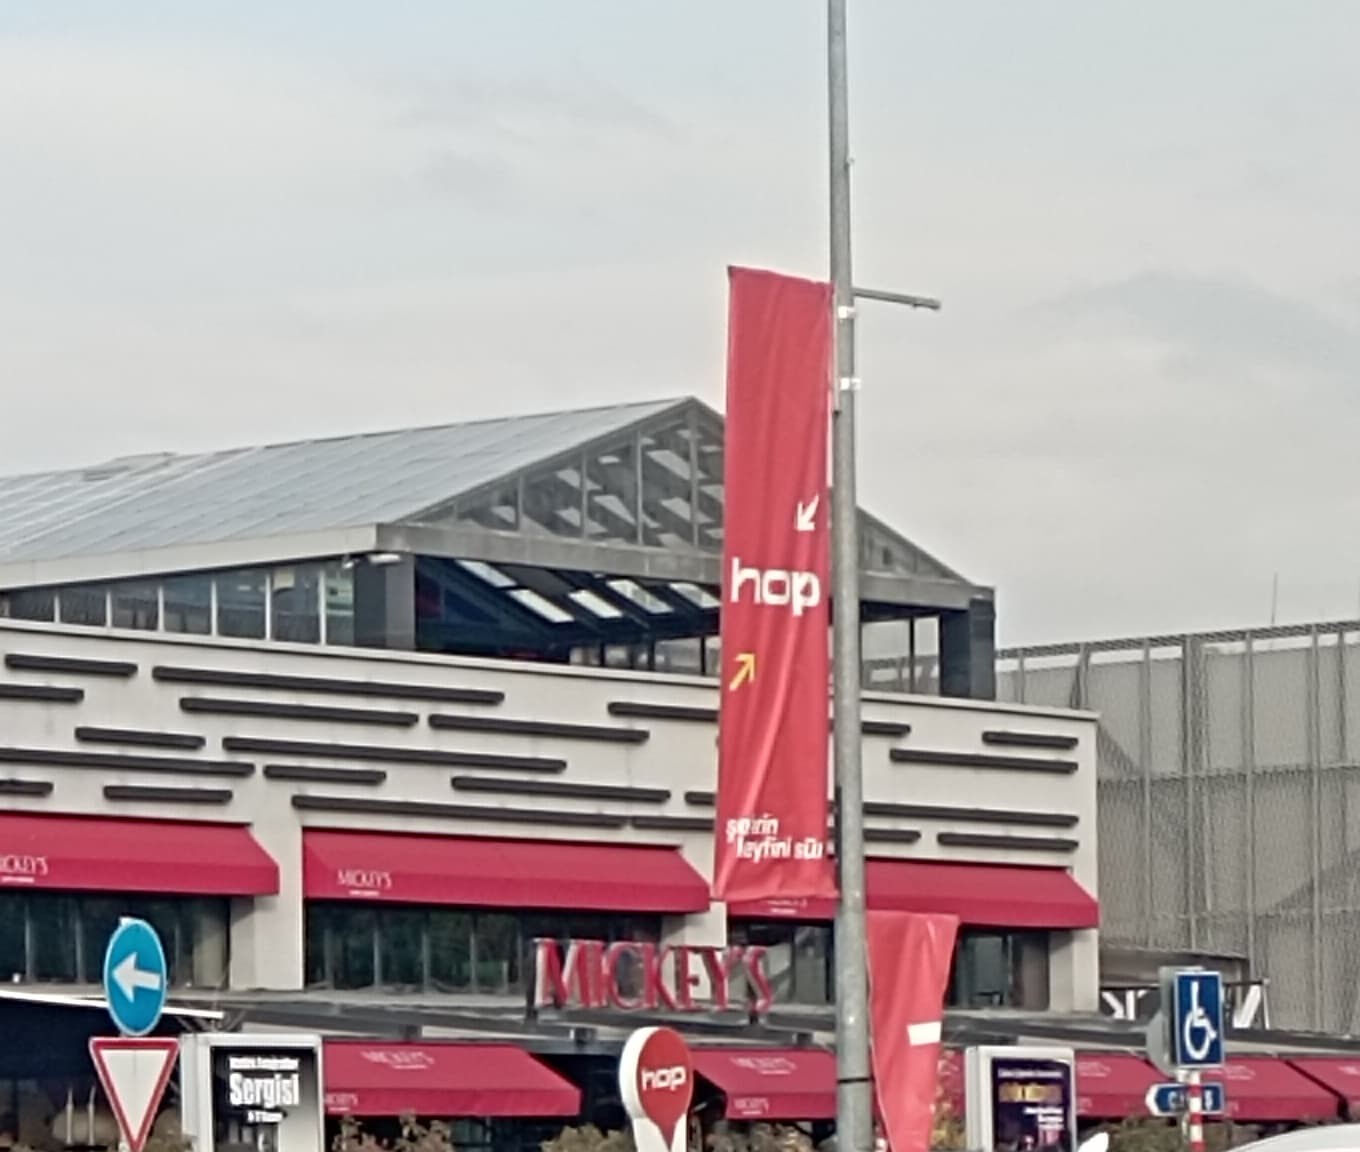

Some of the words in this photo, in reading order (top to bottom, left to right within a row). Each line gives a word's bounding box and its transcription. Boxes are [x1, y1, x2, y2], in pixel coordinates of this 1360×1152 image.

[731, 556, 820, 617] hop
[532, 937, 774, 1014] MICKEY'S
[641, 1066, 686, 1091] hop
